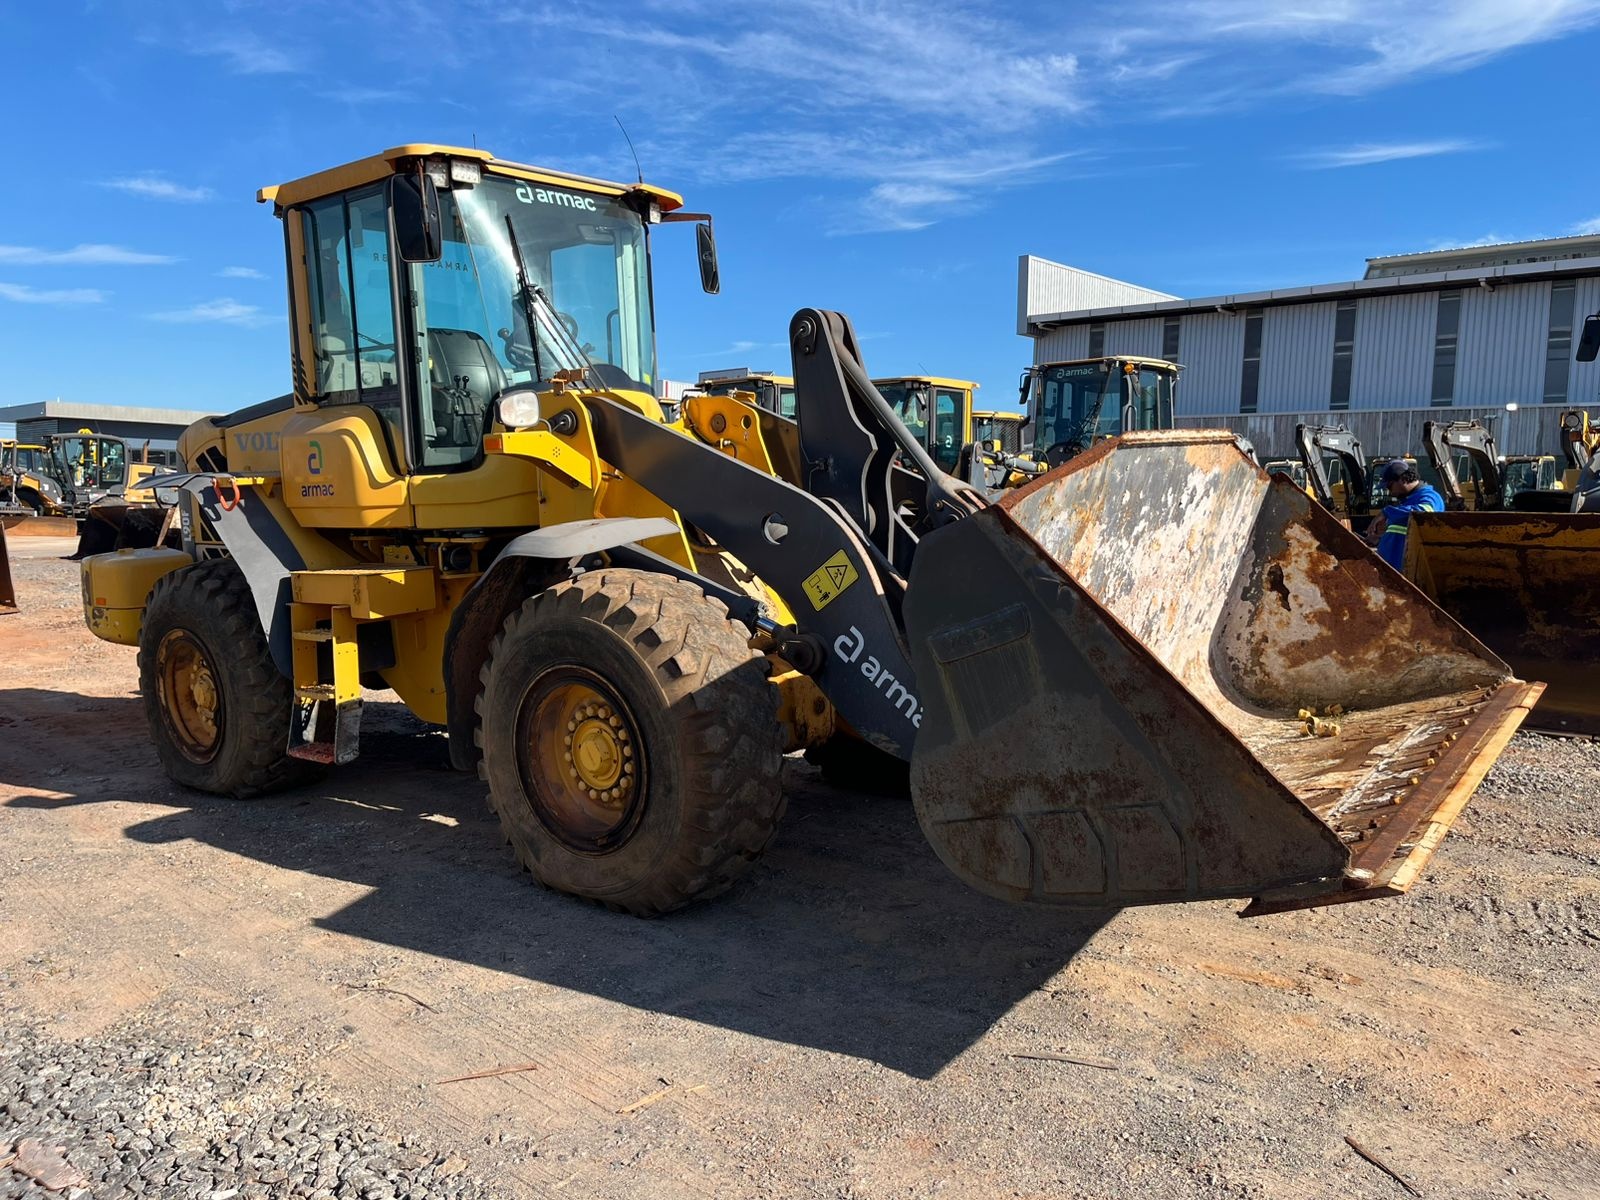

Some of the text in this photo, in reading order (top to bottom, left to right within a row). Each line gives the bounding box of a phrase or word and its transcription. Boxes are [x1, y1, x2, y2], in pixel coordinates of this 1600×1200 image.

[535, 188, 597, 212] armac
[1065, 367, 1094, 377] armac
[233, 431, 281, 452] VOL
[301, 484, 335, 497] armac
[181, 510, 192, 542] L90F
[860, 655, 924, 729] arm
